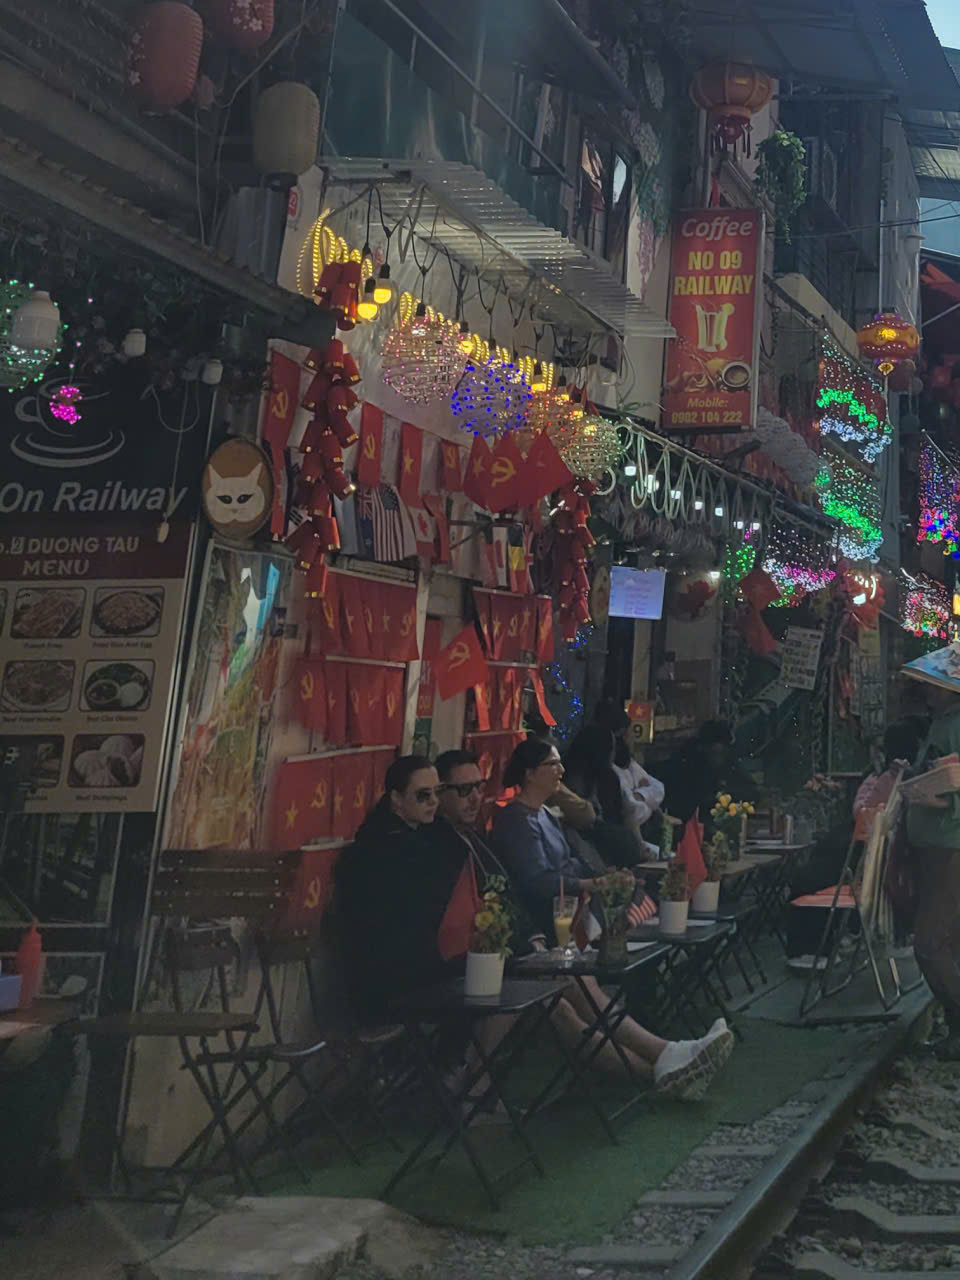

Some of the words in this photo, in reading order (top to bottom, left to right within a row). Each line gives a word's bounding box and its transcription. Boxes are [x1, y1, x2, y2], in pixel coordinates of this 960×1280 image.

[681, 216, 753, 241] Coffee
[687, 250, 714, 271] NO
[719, 250, 743, 270] 09
[674, 274, 754, 296] RAILWAY
[687, 396, 728, 408] Mobile:
[722, 410, 743, 423] 222
[0, 482, 45, 513] On
[53, 480, 189, 518] Railway
[28, 537, 100, 554] DUONG
[106, 536, 140, 553] TAU
[22, 559, 91, 577] MENU
